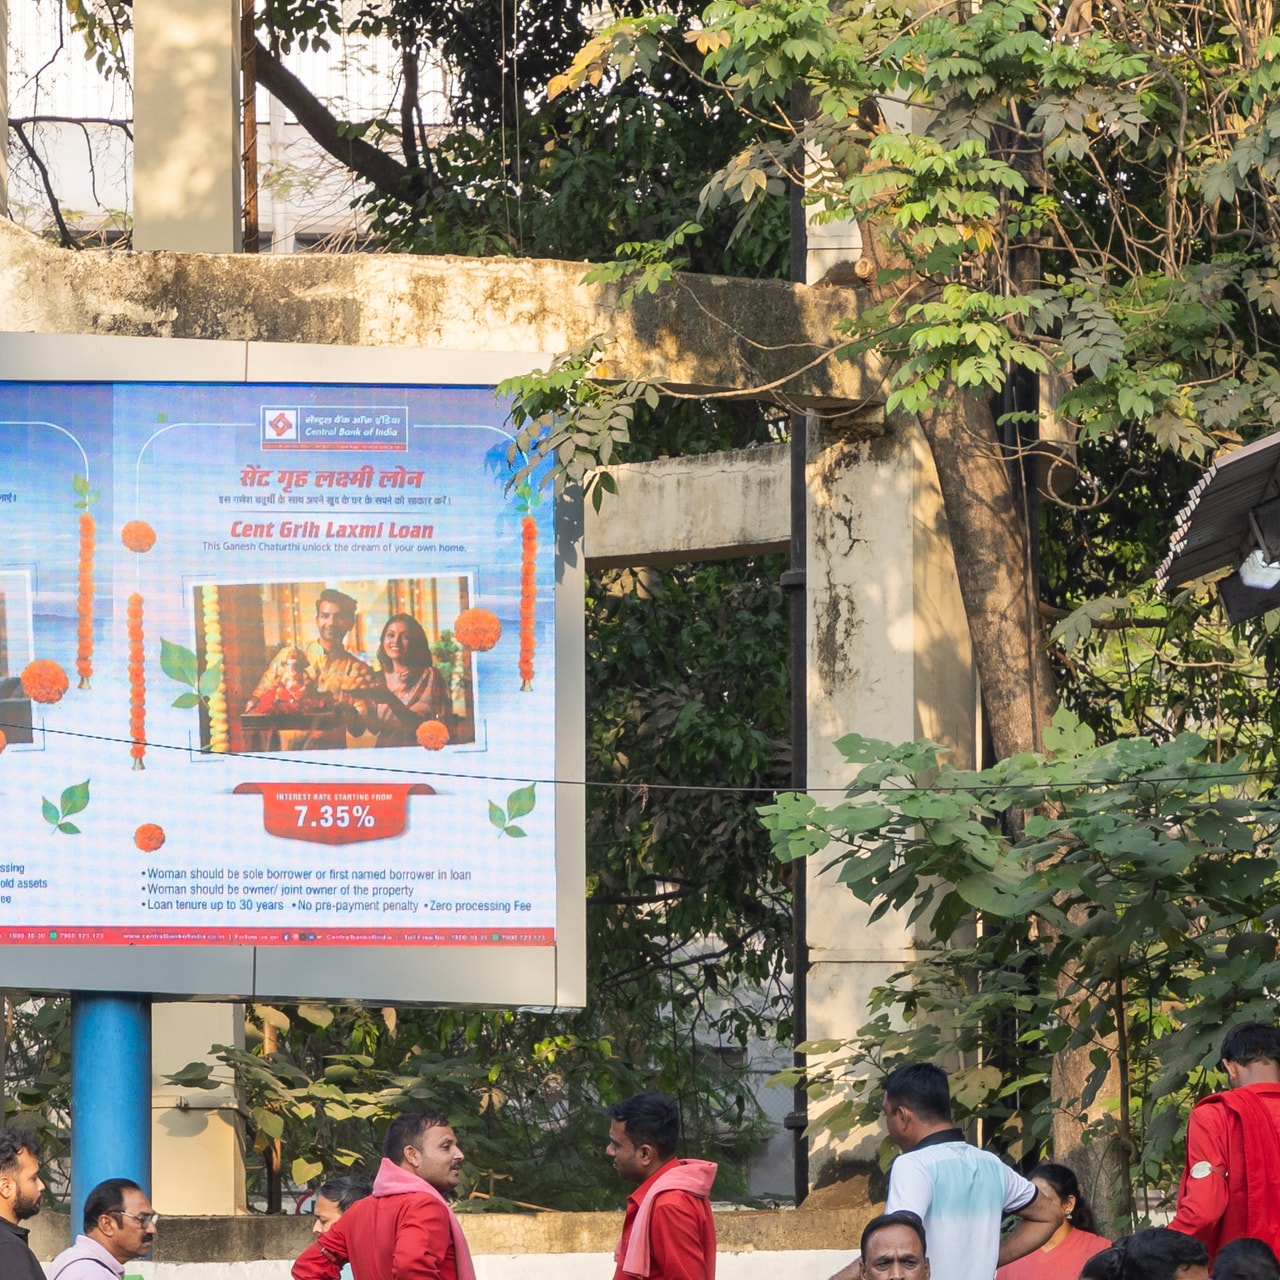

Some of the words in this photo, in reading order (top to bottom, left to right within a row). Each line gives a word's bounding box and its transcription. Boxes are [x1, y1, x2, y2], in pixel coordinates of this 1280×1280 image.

[306, 428, 336, 436] Central
[339, 428, 361, 436] Bank
[363, 428, 373, 436] of
[376, 428, 398, 436] India
[240, 464, 273, 487] सेंट
[277, 470, 311, 493] गृह
[314, 464, 375, 488] लक्ष्मी
[379, 466, 424, 488] लोन
[230, 520, 274, 538] Cent
[280, 520, 320, 538] Grih
[326, 520, 383, 538] Laxmi
[388, 522, 434, 539] Loan
[203, 541, 220, 551] This
[223, 541, 256, 551] Ganesh
[258, 541, 300, 551] Chaturthi
[302, 541, 331, 551] unlock
[334, 541, 349, 551] the
[352, 541, 379, 551] dream
[382, 541, 392, 551] of
[394, 543, 414, 553] your
[417, 544, 436, 552] own
[294, 805, 375, 827] 7.35%
[147, 868, 186, 879] Woman
[190, 868, 223, 879] should
[228, 868, 239, 879] be
[243, 868, 263, 879] sole
[267, 868, 312, 879] borrower
[315, 871, 325, 879] or
[329, 869, 348, 880] first
[352, 869, 385, 880] named
[389, 869, 434, 880] borrower
[438, 869, 446, 880] in
[450, 869, 471, 880] loan
[17, 878, 48, 888] assets
[147, 884, 186, 894] Woman
[190, 884, 223, 894] should
[228, 884, 239, 894] be
[243, 884, 278, 895] owner/
[281, 884, 302, 896] joint
[306, 886, 337, 895] owner
[340, 885, 350, 895] of
[354, 885, 368, 895] the
[372, 885, 414, 897] property
[147, 899, 173, 910] Loan
[176, 900, 207, 910] tenure
[211, 902, 223, 912] up
[227, 900, 235, 910] to
[240, 900, 253, 910] 30
[256, 902, 283, 912] years
[298, 900, 312, 911] No
[315, 902, 379, 913] pre-payment
[383, 900, 418, 913] penalty
[430, 901, 452, 911] Zero
[456, 901, 510, 913] processing
[514, 901, 531, 911] Fee
